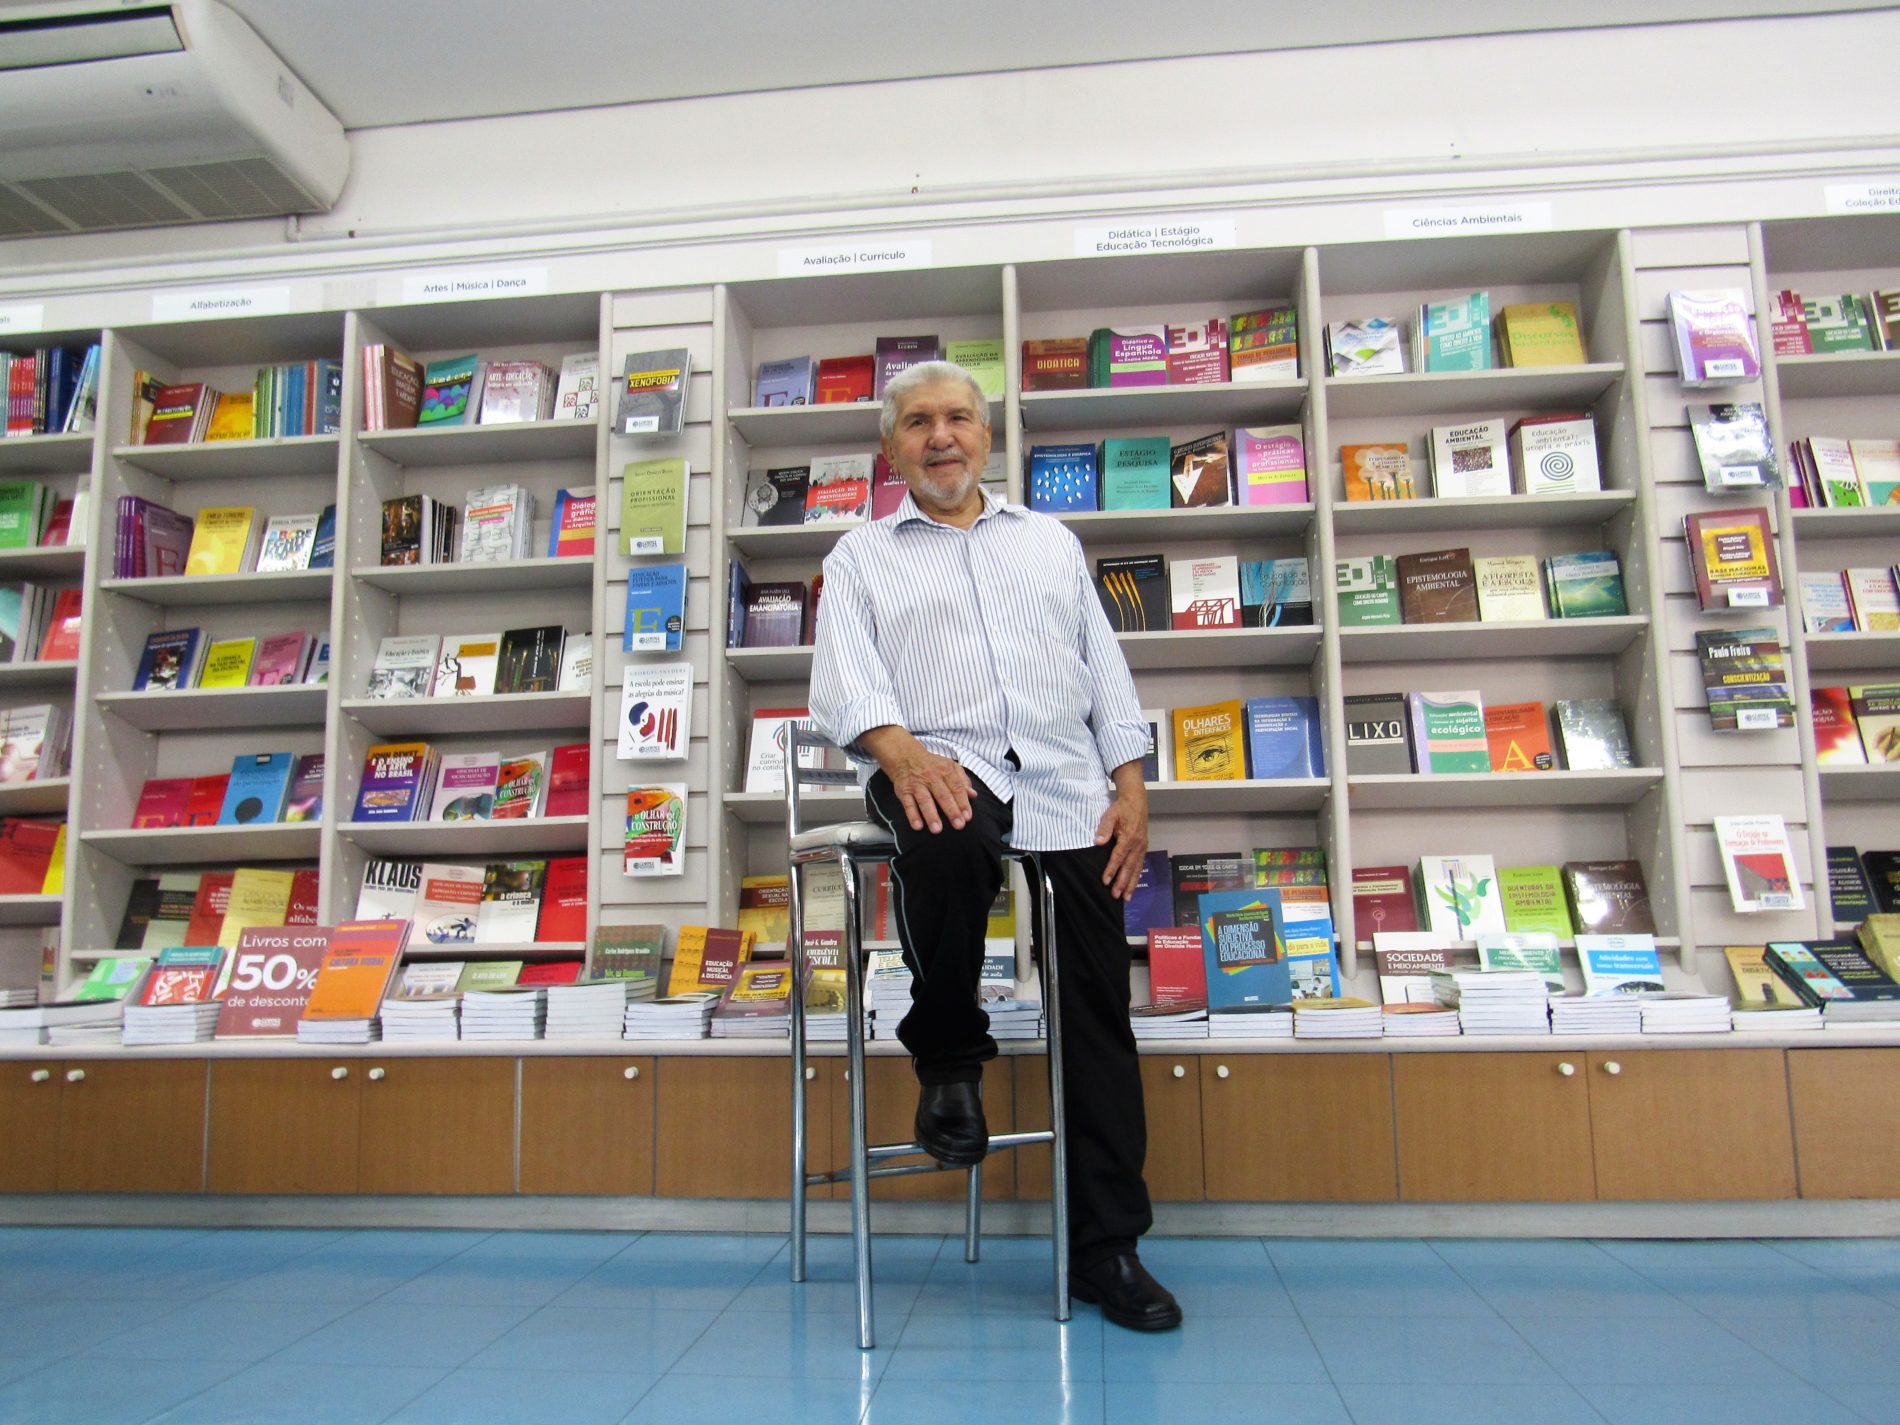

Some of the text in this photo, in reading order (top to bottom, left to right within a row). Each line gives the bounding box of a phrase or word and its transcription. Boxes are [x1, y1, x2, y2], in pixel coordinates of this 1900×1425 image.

[1845, 198, 1900, 208] Coleção Ed
[1412, 213, 1523, 228] Ciências Ambientais
[1108, 226, 1200, 240] Didática Estágio
[1096, 236, 1213, 252] Educação Tecnológica
[803, 250, 905, 266] Avaliação Currículo
[423, 278, 526, 293] Artes Música Dança
[190, 297, 252, 310] Alfabetização
[1115, 349, 1161, 357] Espanhola
[1123, 344, 1153, 352] Língua
[885, 362, 914, 370] Avalia
[628, 375, 676, 389] XENOFOBIA
[1449, 425, 1489, 438] EDUCAÇÃO
[1445, 434, 1484, 444] AMBIENTAL
[571, 501, 596, 510] Diálog
[571, 509, 594, 518] gráfic
[1406, 570, 1468, 584] EPISTEMOLOGIA
[1415, 579, 1461, 591] AMBIENTAL
[758, 594, 791, 604] AVALIAÇÃO
[749, 602, 799, 613] EMANCIPATÓRIA
[635, 679, 651, 687] escola
[651, 678, 665, 688] pode
[1183, 713, 1231, 730] OLHARES
[1349, 720, 1401, 740] LIXO
[1431, 724, 1481, 736] ecológico
[374, 769, 414, 779] NO BRASIL
[640, 809, 665, 820] OLHAR
[631, 820, 678, 832] CONSTRUÇÃO
[364, 860, 423, 889] KLAUS
[812, 884, 844, 893] CURRÍCU
[288, 914, 318, 924] alfabe
[1217, 921, 1259, 935] A DIMENSÃO
[242, 935, 327, 948] Livros com
[1218, 931, 1253, 943] SUBJETIVA
[1219, 940, 1266, 952] DO PROCESSO
[1220, 949, 1266, 962] EDUCACIONAL
[1386, 952, 1445, 963] SOCIEDADE
[705, 959, 734, 967] EDUCAÇÃO
[231, 953, 319, 991] 50%
[705, 971, 733, 980] DISTÂNCIA
[227, 996, 245, 1007] de
